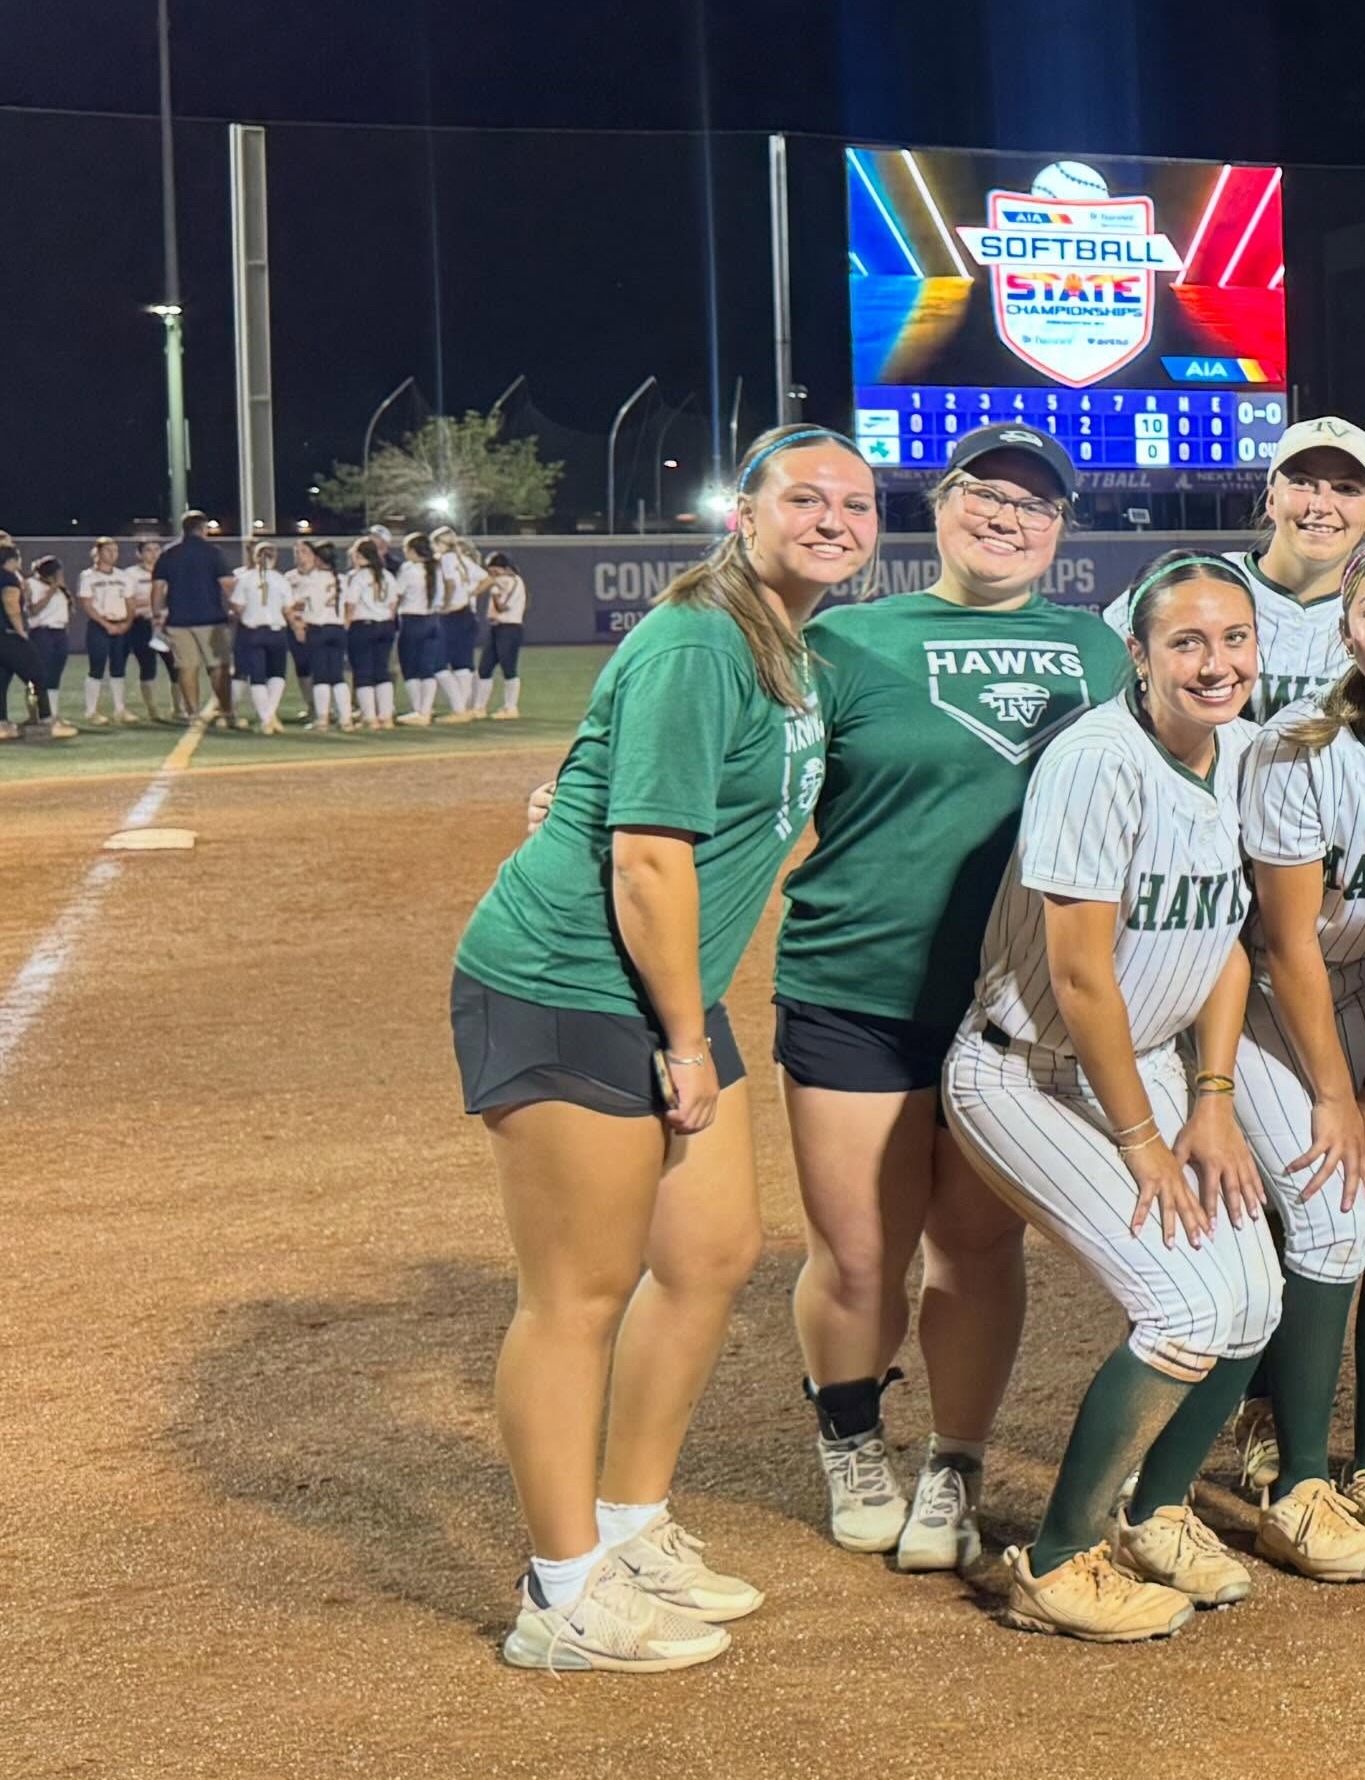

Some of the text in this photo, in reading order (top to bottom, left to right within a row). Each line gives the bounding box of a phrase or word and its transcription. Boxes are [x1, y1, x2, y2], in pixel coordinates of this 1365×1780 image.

[1016, 212, 1043, 224] AIA
[981, 236, 1164, 263] SOFTBALL
[1006, 272, 1141, 304] STATE
[1006, 304, 1143, 318] CHAMPIONSHIPS
[1185, 360, 1229, 378] AIA
[911, 392, 1221, 413] 1 2 3 4 5 6 7 R H E
[1238, 402, 1282, 425] 0-0
[910, 413, 923, 433] 0
[945, 414, 957, 434] 0
[1047, 415, 1057, 434] 1
[1080, 416, 1091, 435] 2
[1142, 419, 1162, 433] 10
[1178, 417, 1190, 436] 0
[1211, 417, 1223, 436] 0
[911, 439, 924, 460] 0
[1080, 441, 1092, 461] 0
[1147, 444, 1158, 458] 0
[1178, 442, 1190, 461] 0
[1211, 442, 1223, 462] 0
[1238, 437, 1279, 462] 0 OU
[1076, 473, 1152, 488] FTBALL
[1197, 472, 1267, 481] NEXT LEV
[927, 650, 1084, 678] HAWKS
[1127, 866, 1245, 931] HAWK
